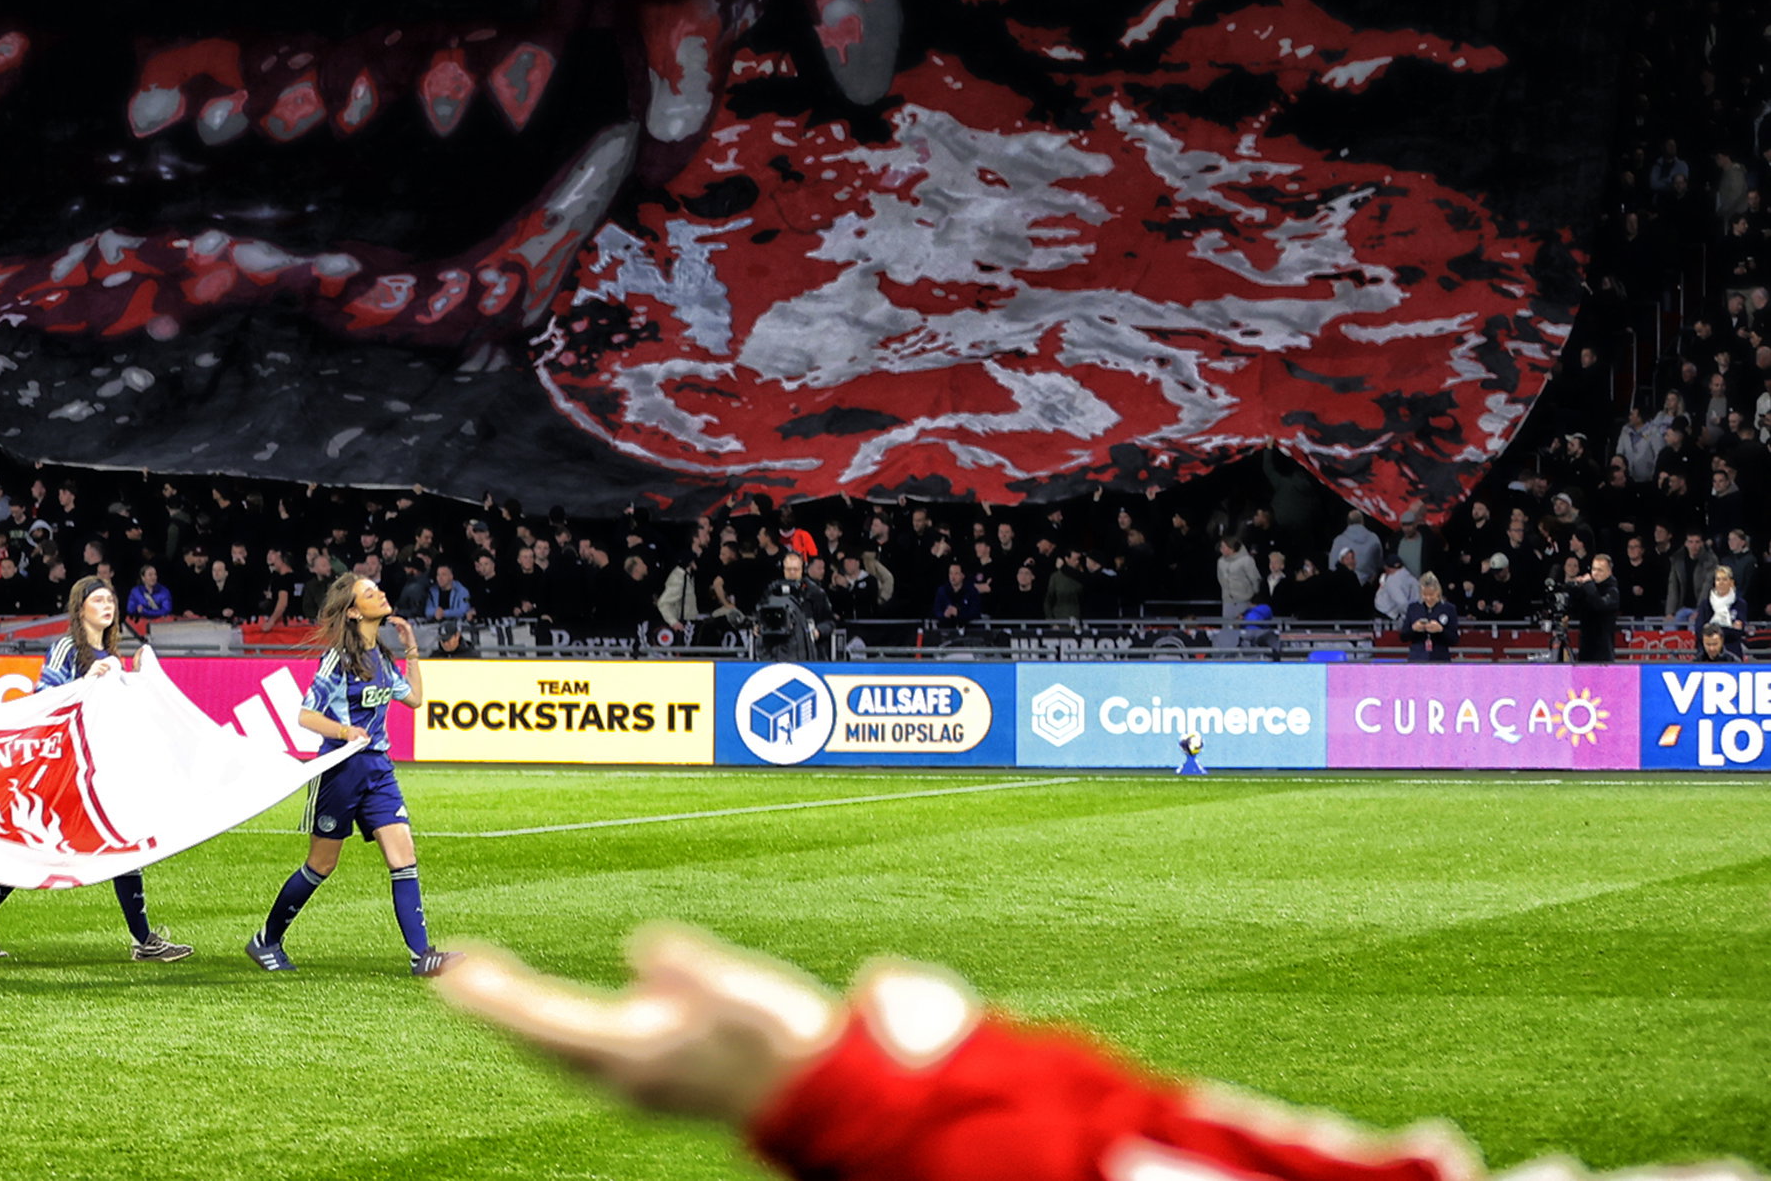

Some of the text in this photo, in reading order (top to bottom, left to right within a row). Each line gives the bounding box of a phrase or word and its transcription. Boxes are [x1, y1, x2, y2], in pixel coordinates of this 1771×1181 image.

[537, 680, 590, 695] TEAM
[857, 687, 952, 714] ALLSAFE
[427, 701, 701, 732] ROCKSTARS IT
[1099, 696, 1311, 735] Coinmerce
[1354, 697, 1598, 744] CURAÇAO
[845, 723, 964, 743] MINI OPSLAG
